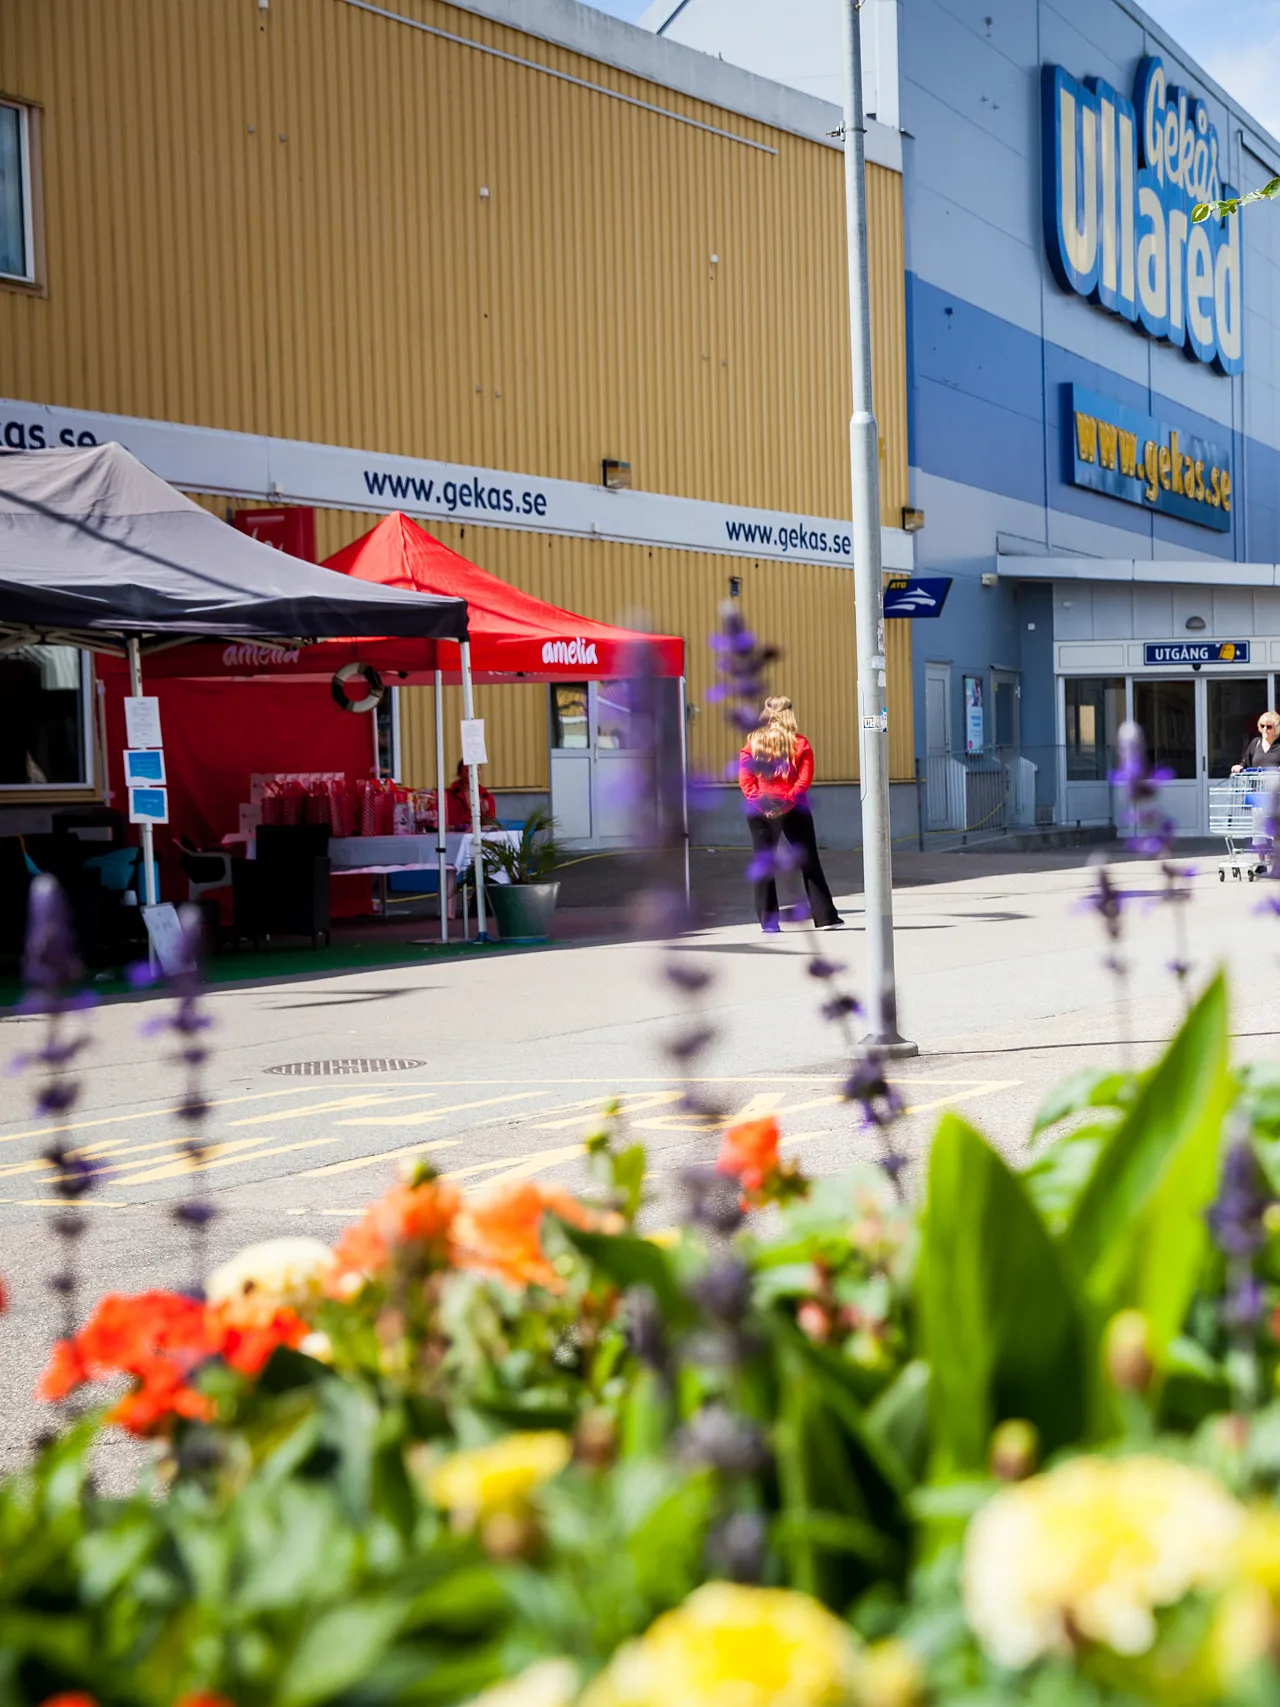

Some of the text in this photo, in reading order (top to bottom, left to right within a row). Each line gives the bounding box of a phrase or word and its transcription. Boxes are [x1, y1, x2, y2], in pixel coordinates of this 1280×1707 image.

[1146, 66, 1221, 222] Gekås
[1060, 86, 1241, 360] Ullared
[1075, 411, 1232, 512] www.gekas.se
[364, 470, 547, 516] www.gekas.se
[726, 520, 851, 555] www.gekas.se
[542, 636, 598, 665] amelia
[1155, 645, 1209, 661] UTGÅNG
